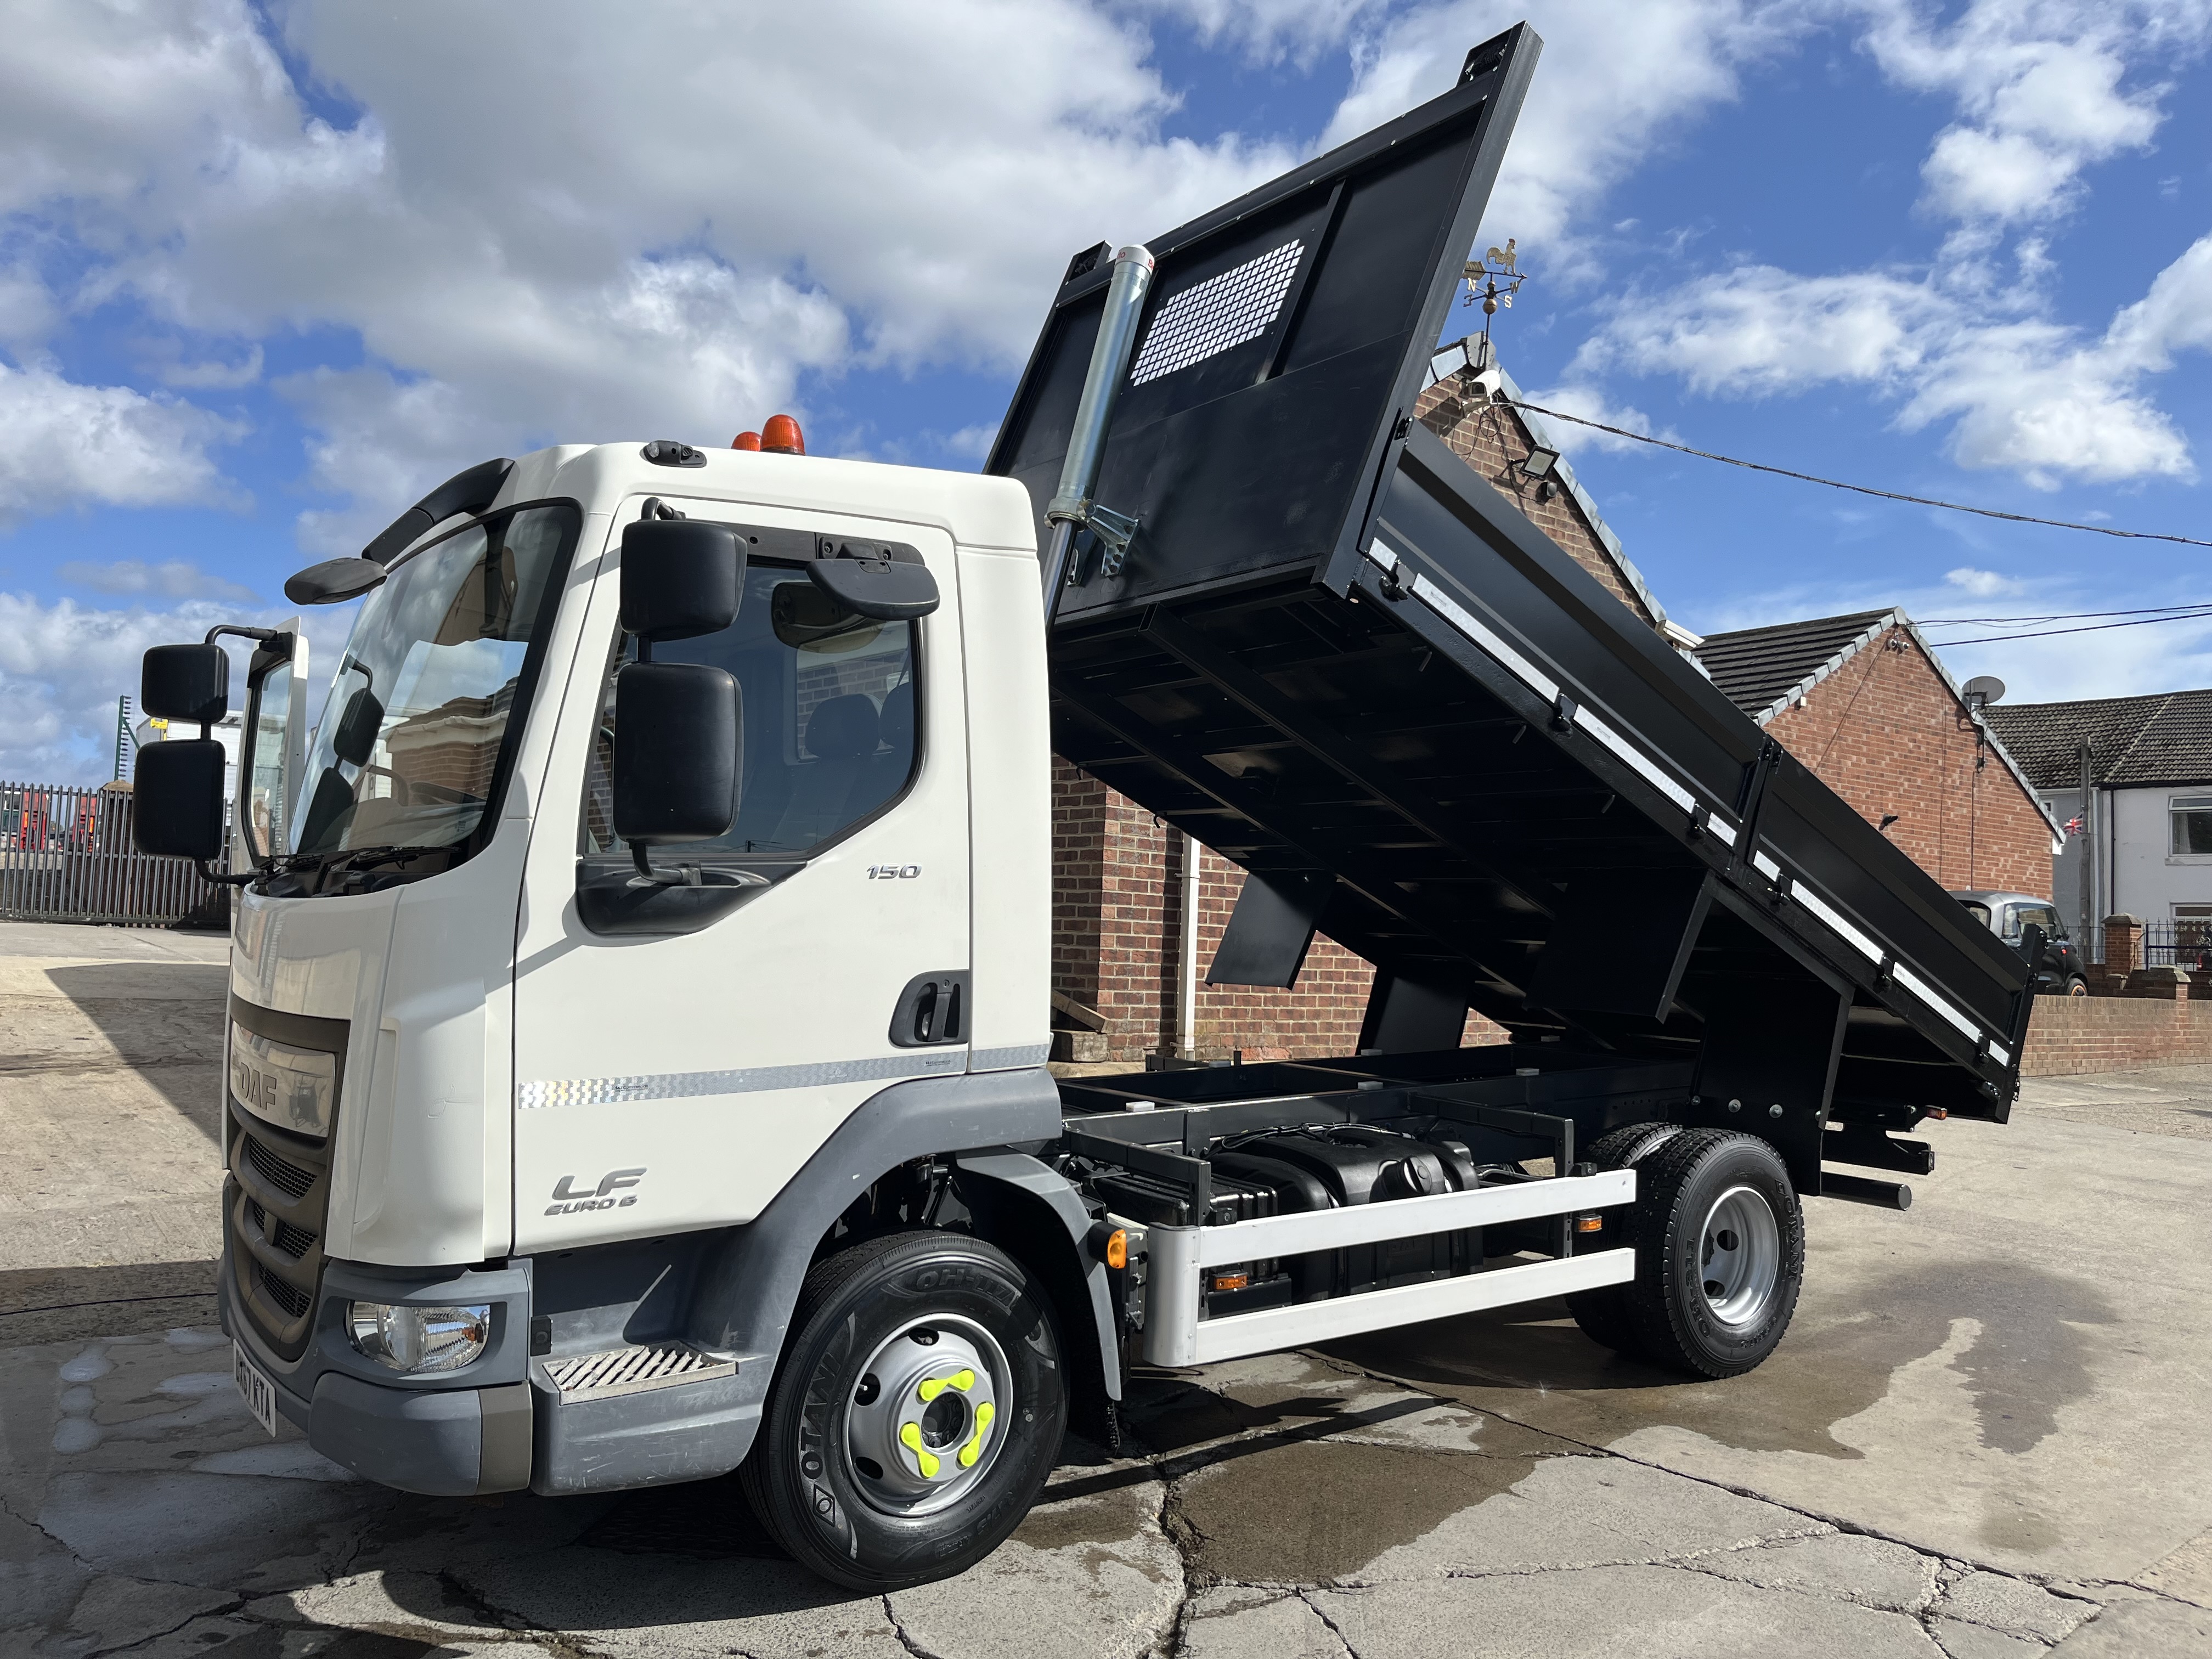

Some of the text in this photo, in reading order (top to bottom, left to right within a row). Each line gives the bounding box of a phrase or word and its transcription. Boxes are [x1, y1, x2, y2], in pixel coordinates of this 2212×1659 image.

[1467, 278, 1476, 292] N
[1509, 280, 1521, 294] W
[1504, 295, 1513, 308] S
[866, 864, 922, 879] 150
[239, 1062, 276, 1110] DAF
[551, 1167, 647, 1200] LF
[544, 1194, 638, 1216] EURO 6
[253, 1373, 271, 1425] KTA
[800, 1352, 842, 1480] OTANI
